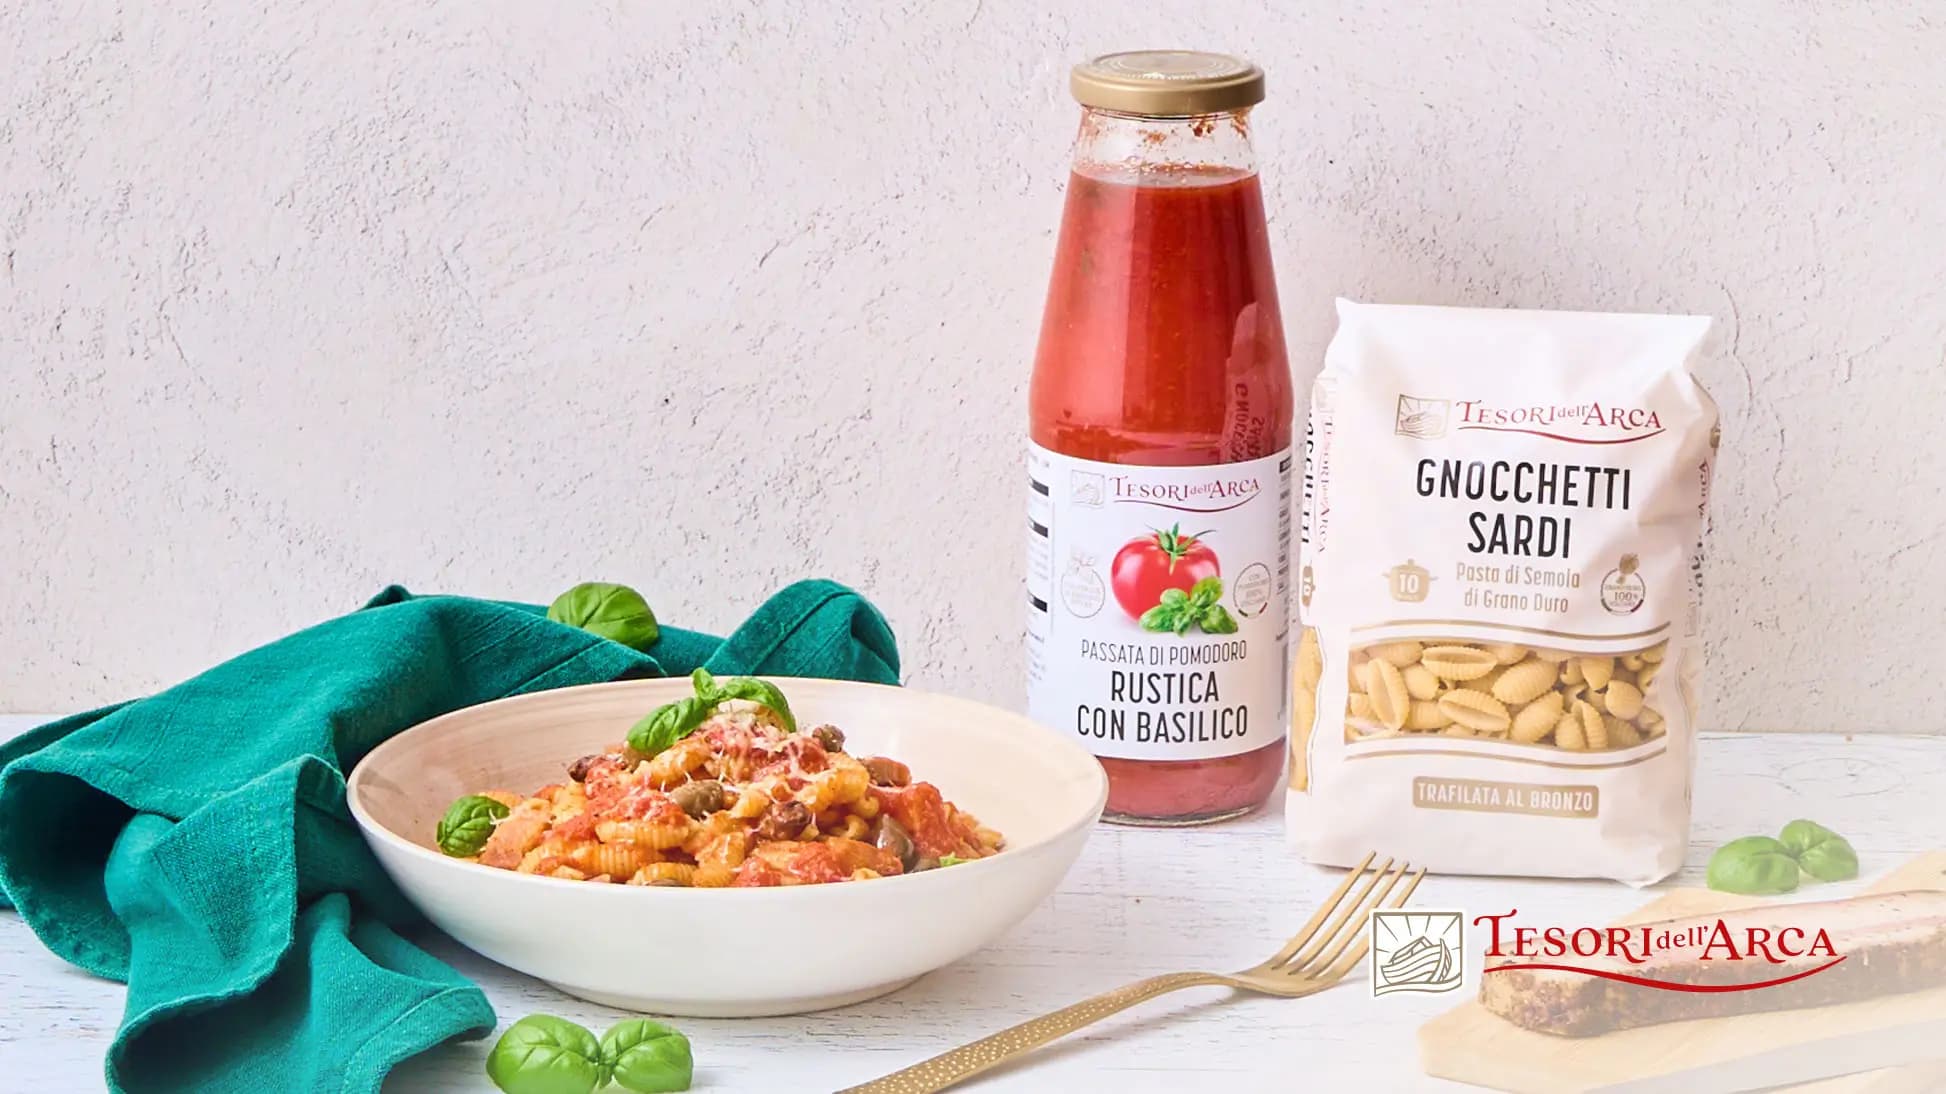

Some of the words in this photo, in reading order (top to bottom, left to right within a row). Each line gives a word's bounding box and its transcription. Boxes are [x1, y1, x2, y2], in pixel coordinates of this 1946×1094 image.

[1416, 459, 1631, 510] GNOCCHETTI
[1467, 511, 1571, 559] SARDI
[1400, 574, 1420, 594] 10
[1456, 562, 1500, 583] Pasta
[1505, 564, 1520, 584] di
[1524, 566, 1580, 588] Semola
[1464, 588, 1478, 607] di
[1483, 590, 1528, 610] Grano
[1533, 593, 1569, 613] Duro
[1081, 639, 1145, 665] PASSATA
[1150, 643, 1164, 666] DI
[1169, 640, 1247, 666] POMODORO
[1111, 670, 1219, 704] RUSTICA
[1077, 705, 1125, 741] CON
[1137, 705, 1248, 743] BASILICO
[1418, 783, 1500, 805] TRAFILATA
[1505, 789, 1524, 807] AL
[1530, 791, 1592, 812] BRONZO
